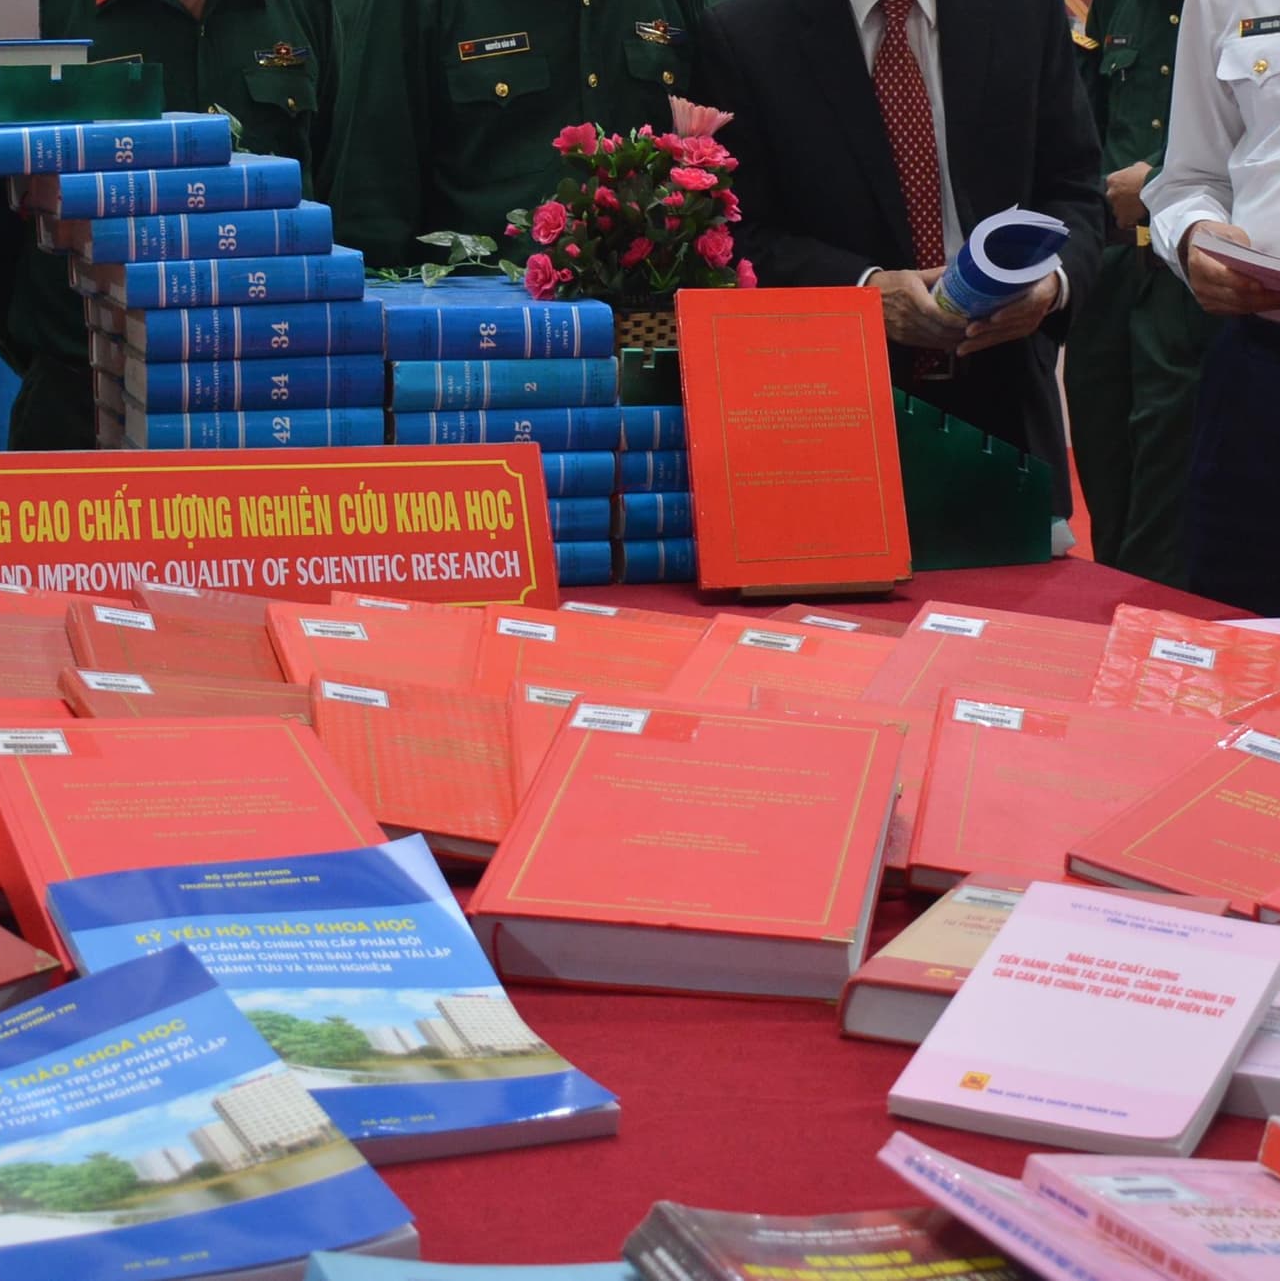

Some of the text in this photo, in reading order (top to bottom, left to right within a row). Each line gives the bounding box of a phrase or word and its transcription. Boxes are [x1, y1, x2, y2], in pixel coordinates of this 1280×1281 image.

[115, 135, 134, 164] 35
[187, 182, 206, 209] 35
[218, 223, 238, 251] 35
[248, 271, 267, 299] 35
[271, 321, 289, 349] 34
[479, 322, 498, 351] 34
[271, 373, 289, 401] 34
[524, 381, 538, 393] 2
[272, 416, 291, 445] 42
[19, 499, 70, 543] CAO
[78, 483, 142, 542] CHẤT
[149, 493, 233, 549] LƯỢNG
[239, 485, 333, 537] NGHIÊN
[338, 481, 388, 535] CỨU
[393, 491, 461, 533] KHOA
[465, 489, 514, 540] HỌC
[38, 561, 158, 592] IMPROVING
[164, 558, 256, 588] QUALITY
[262, 558, 289, 587] OF
[296, 554, 408, 585] SCIENTIFIC
[412, 550, 521, 582] RESEARCH
[169, 924, 211, 941] YẾU
[216, 924, 253, 938] HỘI
[254, 919, 311, 936] THẢO
[314, 921, 370, 935] KHOA
[373, 918, 417, 933] HỌC
[7, 1062, 70, 1089] THẢO
[72, 1038, 136, 1069] KHOA
[138, 1018, 188, 1044] HỌC
